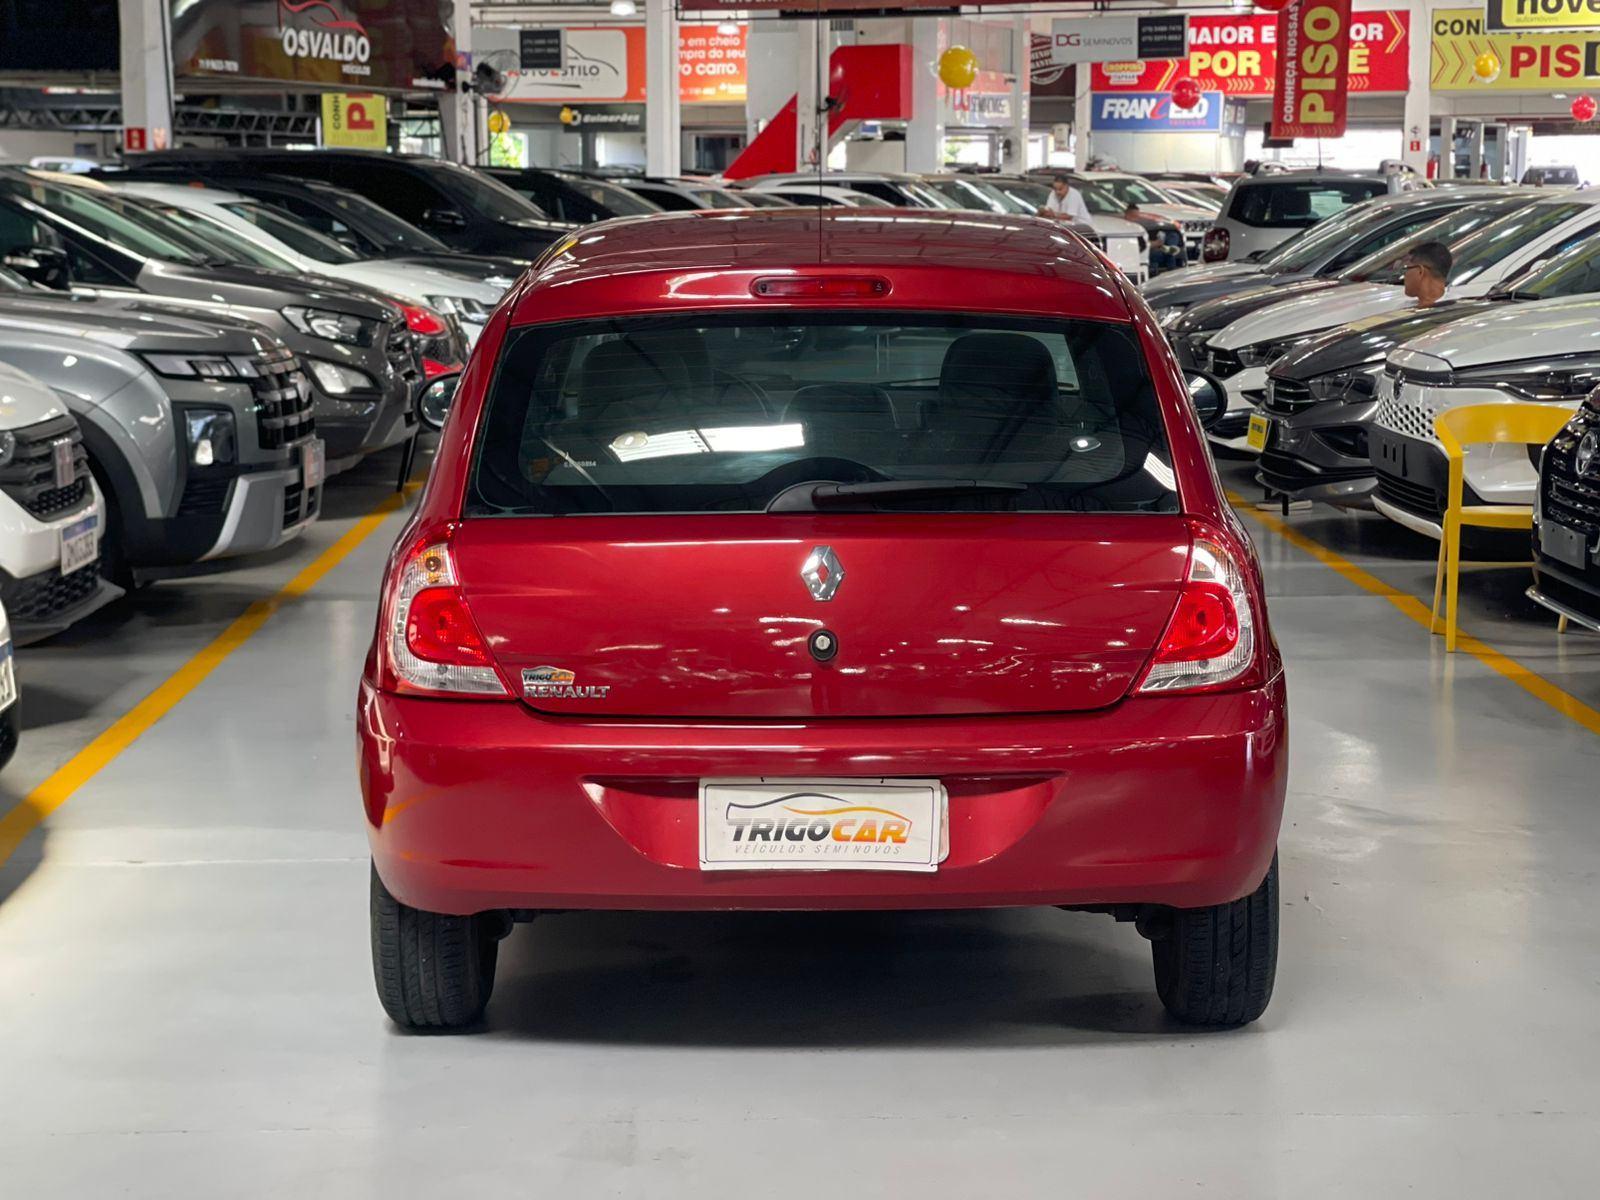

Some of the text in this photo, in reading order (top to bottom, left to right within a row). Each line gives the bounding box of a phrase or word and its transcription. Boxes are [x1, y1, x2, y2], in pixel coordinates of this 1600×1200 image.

[283, 27, 371, 62] OSVALDO
[708, 48, 724, 59] do
[1056, 34, 1080, 46] DG
[1083, 37, 1133, 46] SEMINOVOS
[1189, 50, 1261, 77] POR
[1300, 6, 1340, 124] PISO
[1510, 44, 1582, 78] PIS
[1283, 61, 1297, 123] CONHEÇA
[1101, 97, 1209, 119] FRANCEO
[524, 685, 611, 699] RENAULT
[726, 817, 912, 844] TRIGOCAR
[734, 843, 902, 855] VEÍCULOS SEMINOVOS
